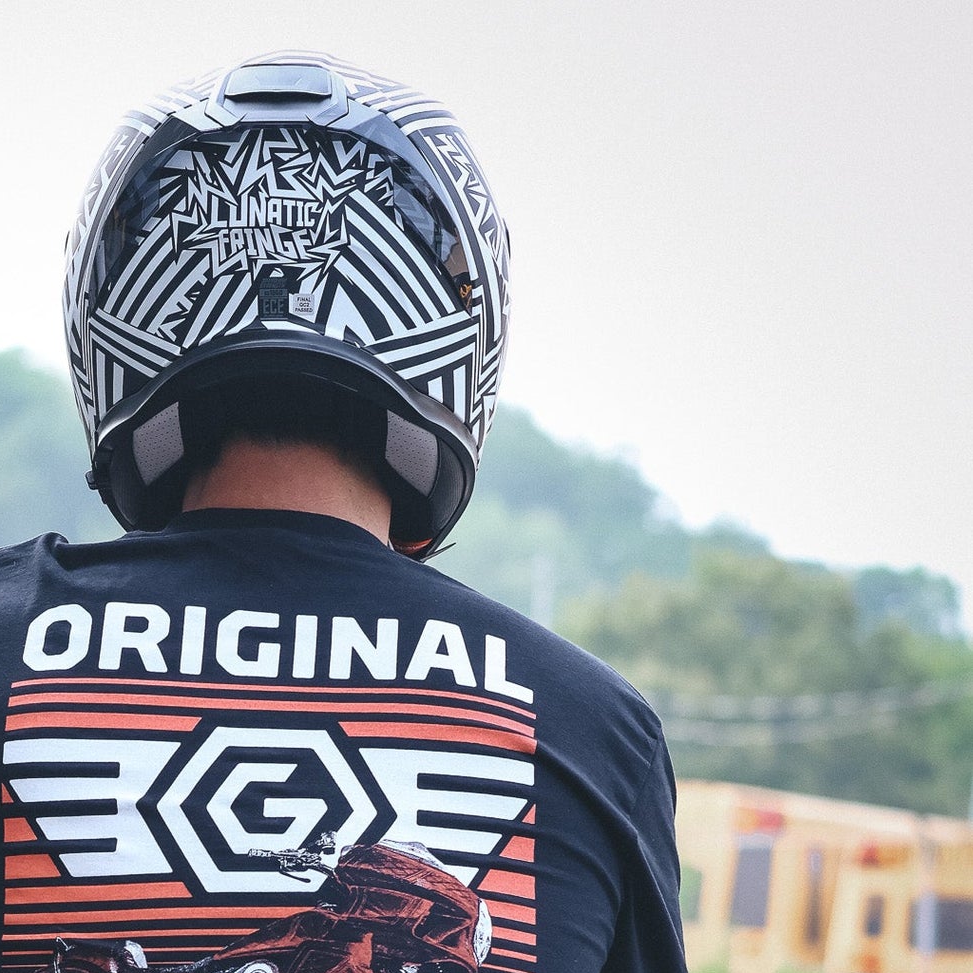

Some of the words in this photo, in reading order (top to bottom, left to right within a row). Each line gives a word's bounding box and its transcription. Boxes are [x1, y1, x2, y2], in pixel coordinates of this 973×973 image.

[204, 186, 321, 231] LUNATIC
[215, 225, 314, 263] FRINGE
[23, 602, 534, 704] ORIGINAL
